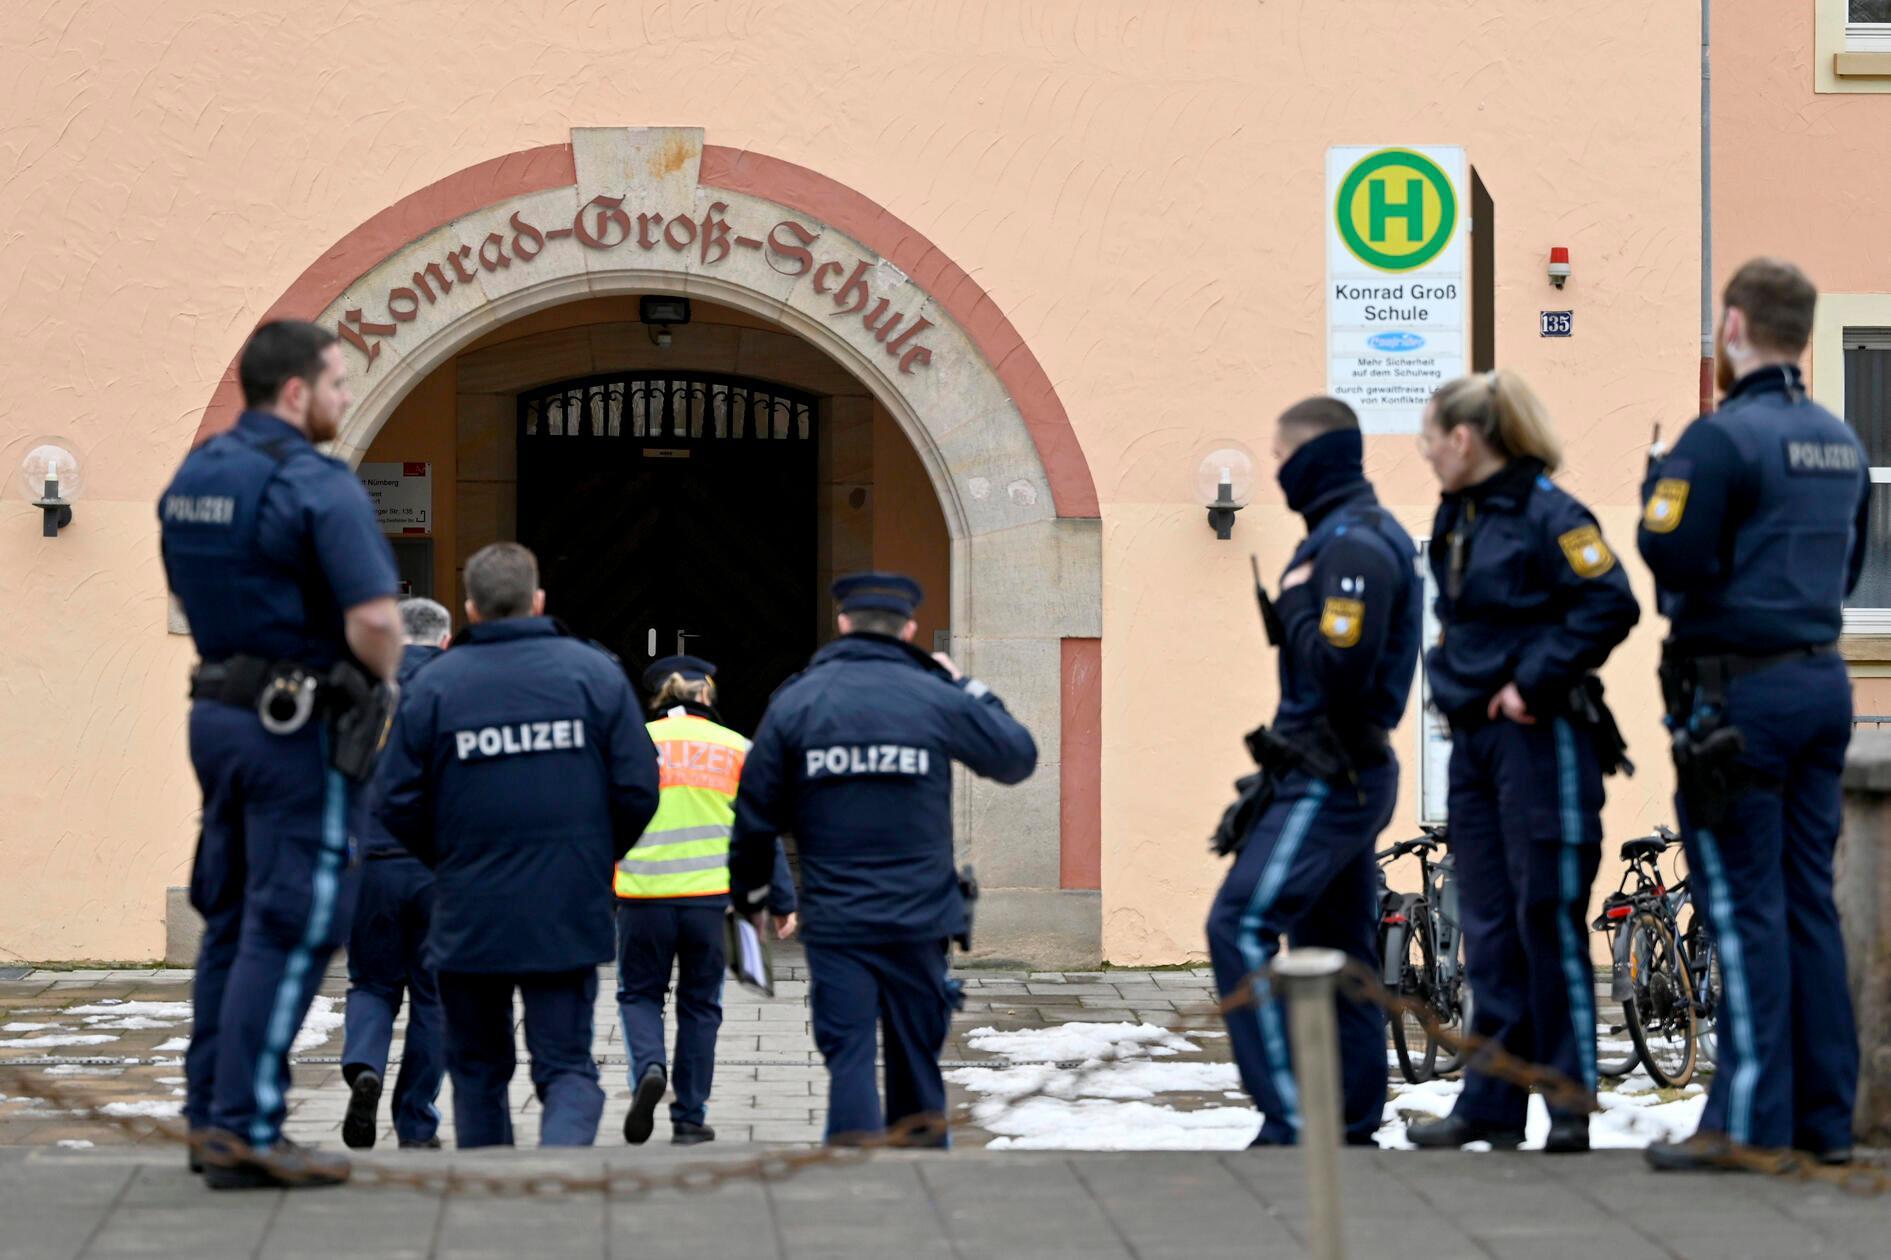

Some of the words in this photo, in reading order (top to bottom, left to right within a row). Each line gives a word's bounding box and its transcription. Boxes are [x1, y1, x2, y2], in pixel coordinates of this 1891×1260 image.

[1369, 179, 1423, 242] H
[337, 194, 935, 375] Konrad-Groß-Schule
[1335, 284, 1404, 300] Konrad
[1410, 284, 1457, 300] Groß
[1364, 305, 1429, 321] Schule
[1542, 315, 1570, 332] 135
[1358, 358, 1382, 366] Mehr
[1385, 358, 1435, 366] Sicherheit
[1352, 369, 1368, 377] auf
[1370, 369, 1390, 377] dem
[1394, 369, 1441, 379] Schulweg
[1335, 386, 1363, 394] durch
[1366, 386, 1425, 395] gewaltfreies
[1360, 397, 1378, 405] von
[1787, 441, 1858, 470] POLIZEI
[367, 479, 399, 488] Nürnberg
[165, 496, 235, 525] POLIZEI
[455, 719, 585, 760] POLIZEI
[805, 745, 929, 776] POLIZEI
